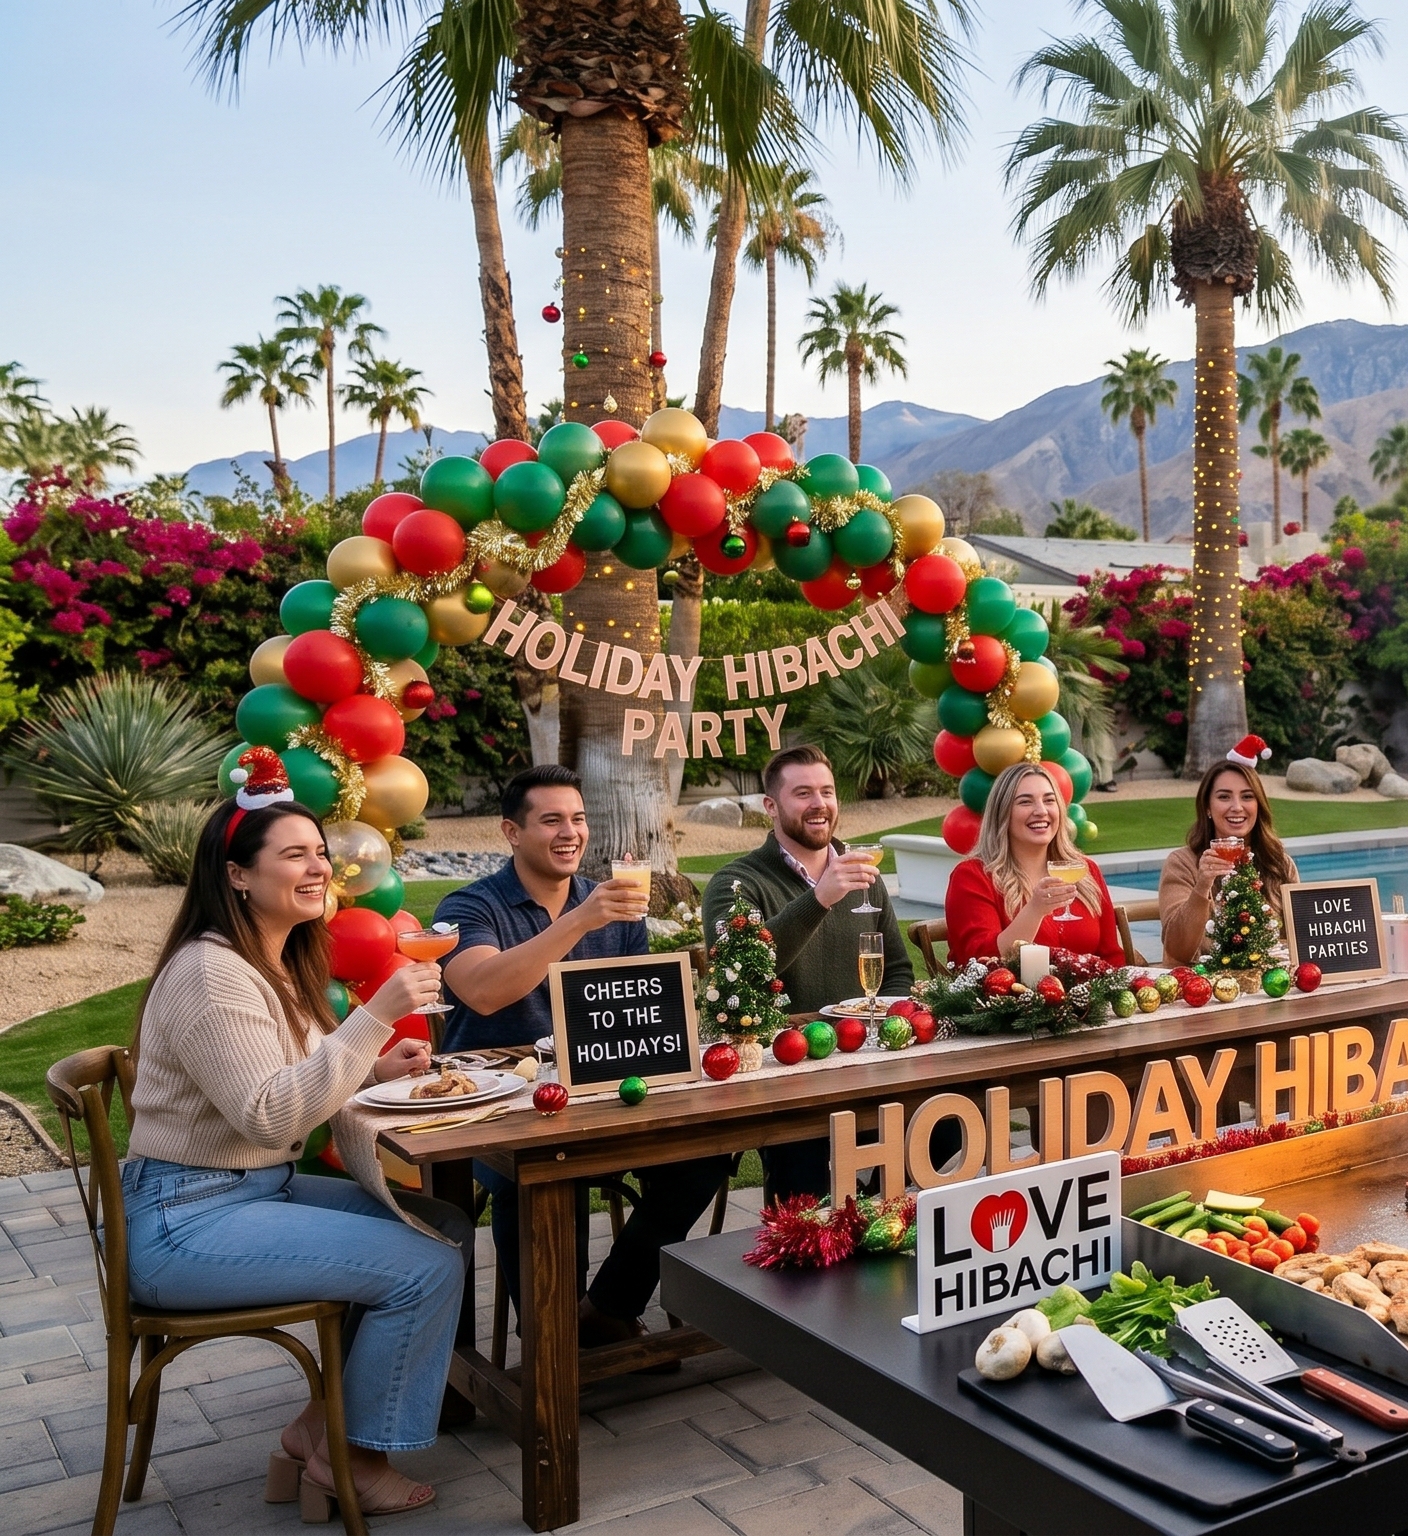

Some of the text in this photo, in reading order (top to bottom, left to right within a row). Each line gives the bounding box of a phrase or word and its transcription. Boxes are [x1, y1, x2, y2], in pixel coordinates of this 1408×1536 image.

[483, 598, 907, 702] HOLIDAY HIBACHI
[621, 703, 788, 759] PARTY
[1314, 898, 1352, 915] LOVE
[1308, 919, 1367, 936] HIBACHI
[1308, 940, 1369, 959] PARTIES
[583, 977, 663, 1001] CHEERS
[588, 1005, 662, 1030] TO THE
[577, 1033, 682, 1064] HOLIDAYS!
[829, 1047, 1237, 1209] HOLIDAY
[933, 1170, 1111, 1268] LOVE
[934, 1236, 1112, 1317] HIBACHI
